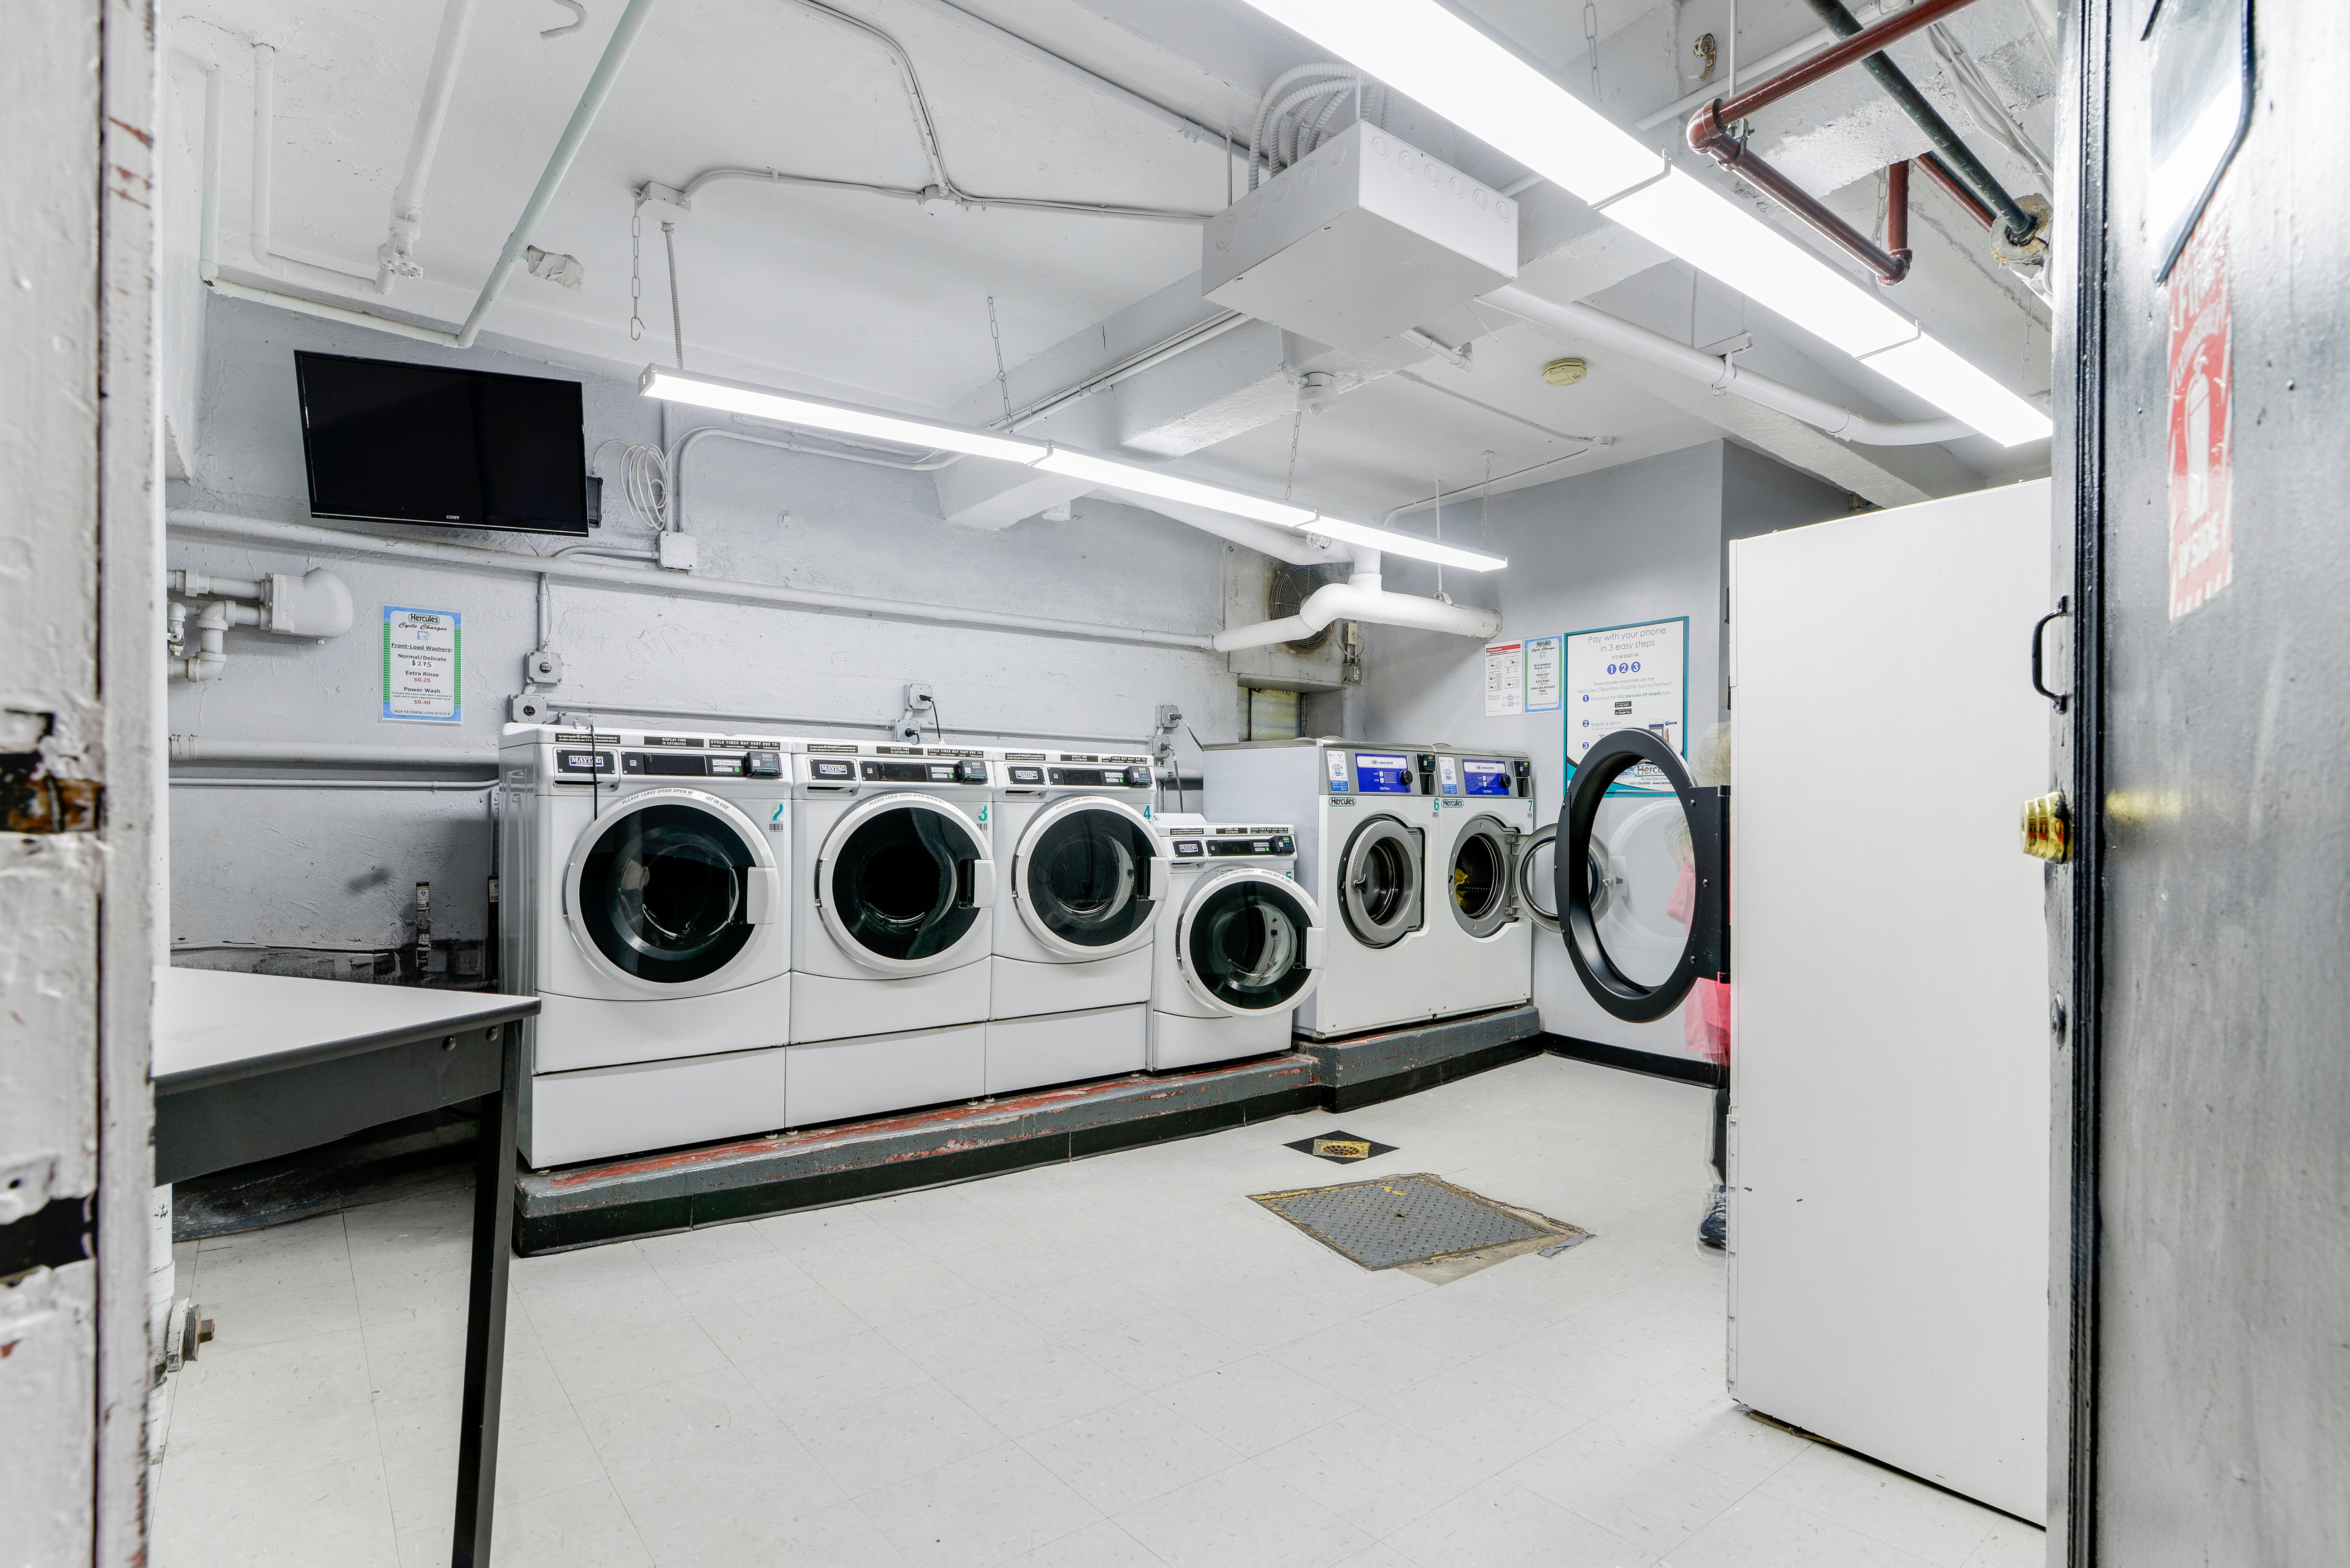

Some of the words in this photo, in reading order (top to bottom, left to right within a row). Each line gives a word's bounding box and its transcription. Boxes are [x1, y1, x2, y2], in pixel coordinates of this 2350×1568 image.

[411, 614, 438, 622] Hercules
[1621, 631, 1638, 641] your
[1640, 628, 1666, 638] phone
[1635, 640, 1655, 648] steps
[1610, 665, 1613, 673] 1
[1633, 663, 1638, 671] 3
[622, 795, 639, 805] PLEASE
[720, 801, 730, 810] USE
[1434, 798, 1439, 811] 6
[1528, 800, 1533, 812] 7
[772, 803, 784, 821] 2
[978, 804, 988, 821] 3
[1143, 805, 1150, 820] 4
